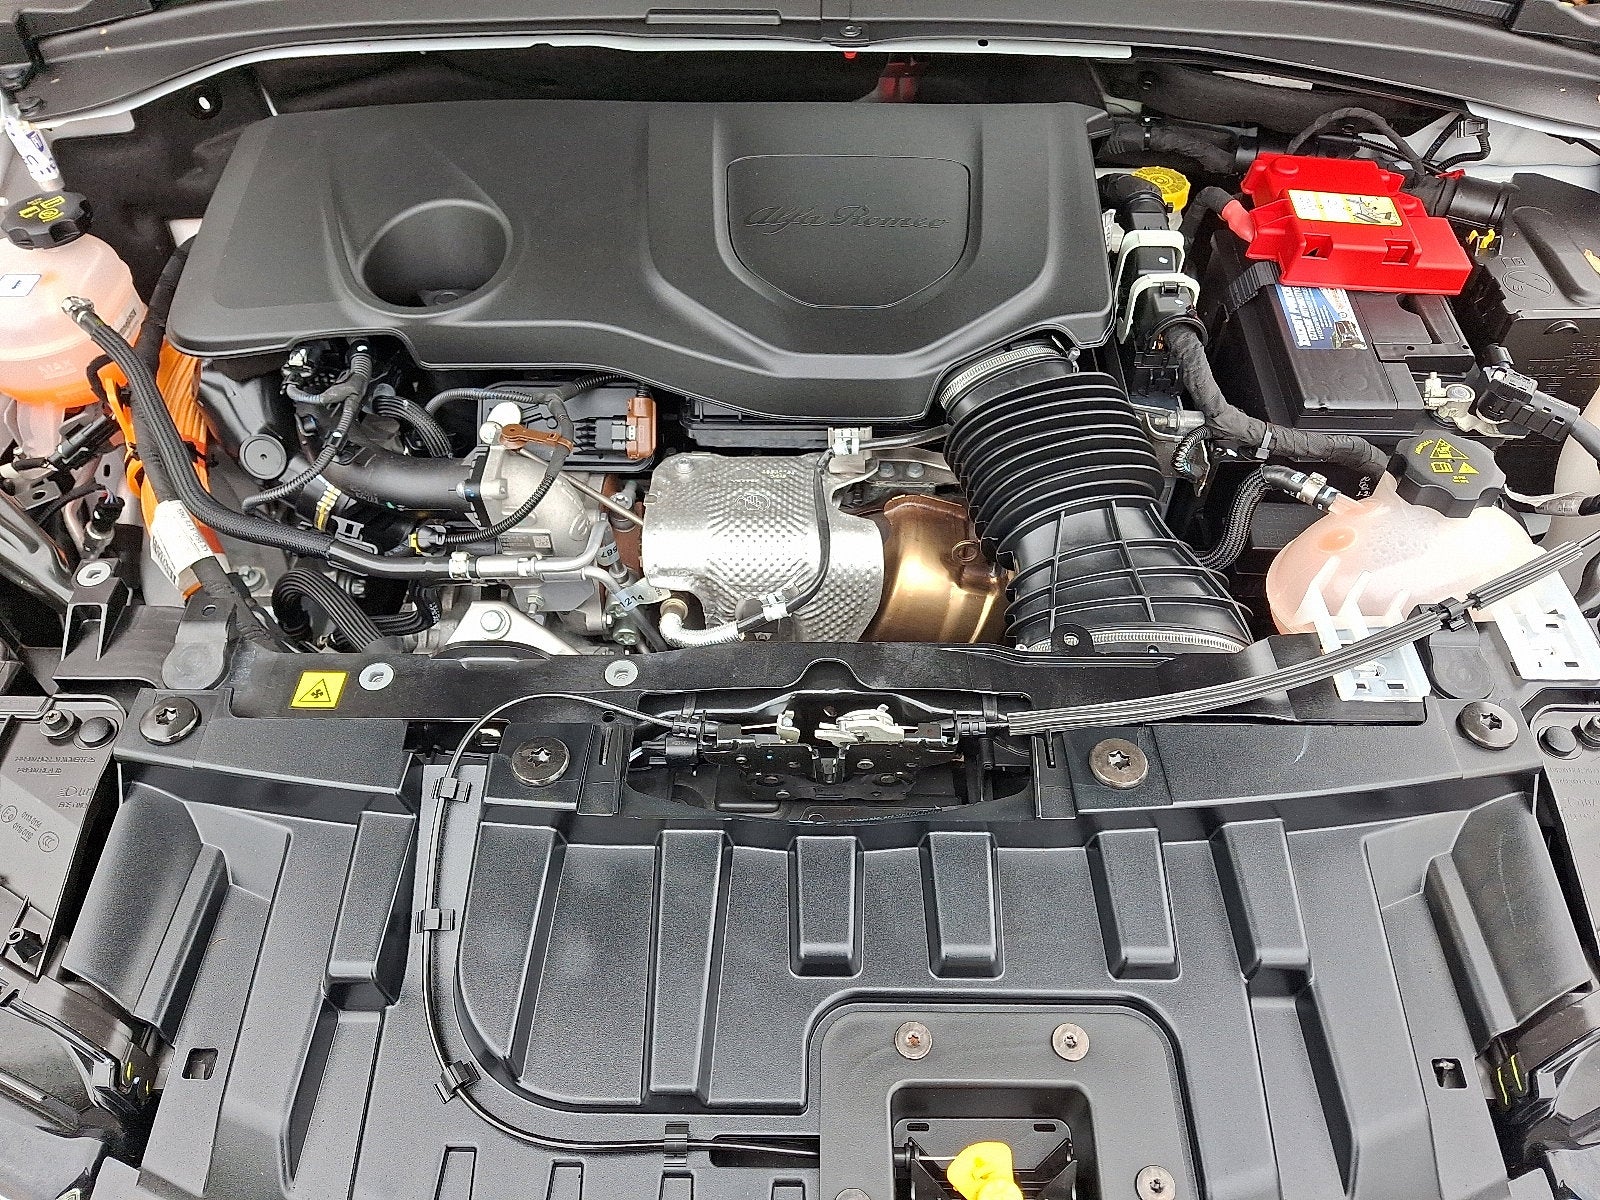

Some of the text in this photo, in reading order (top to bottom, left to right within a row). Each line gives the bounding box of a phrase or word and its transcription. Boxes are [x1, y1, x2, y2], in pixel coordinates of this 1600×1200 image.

[744, 204, 950, 235] Alfa Romeo
[619, 594, 645, 608] 1214
